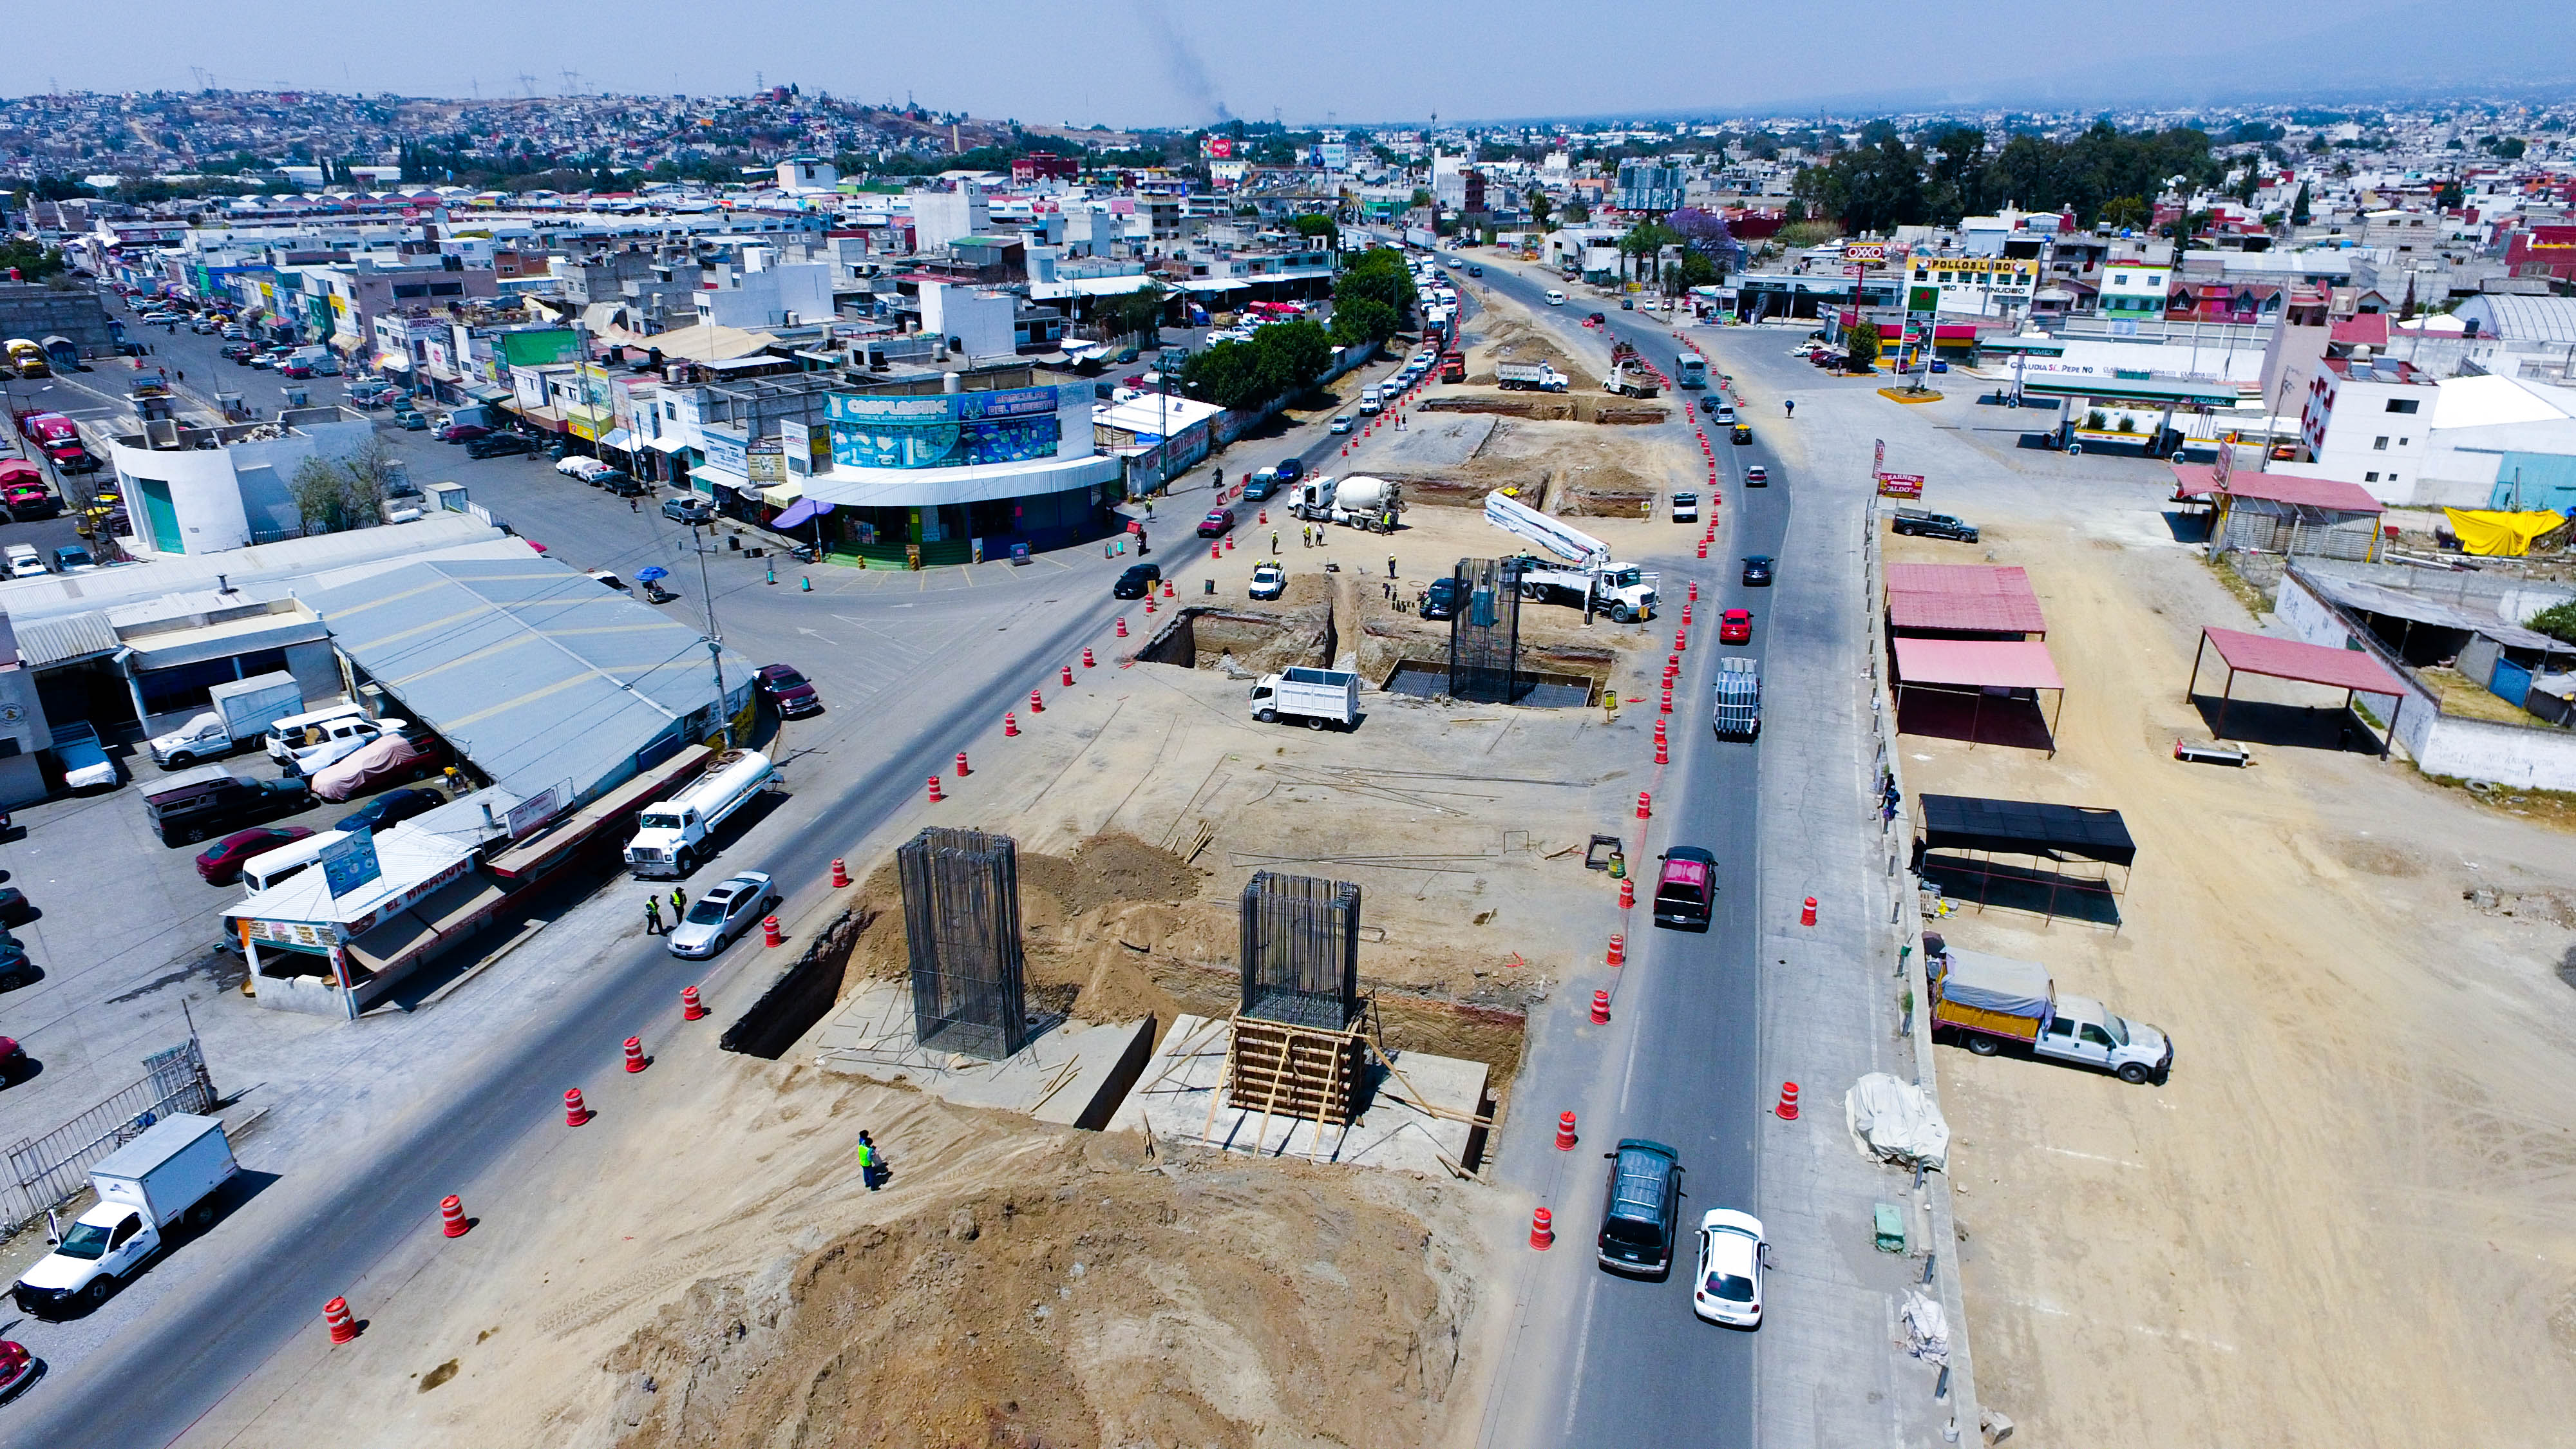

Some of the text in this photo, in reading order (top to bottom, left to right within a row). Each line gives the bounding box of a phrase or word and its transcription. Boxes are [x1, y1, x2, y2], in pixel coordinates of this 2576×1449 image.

[788, 234, 812, 243] DE
[1848, 247, 1881, 258] OXXO
[1932, 260, 1976, 270] POLLOS
[2010, 361, 2047, 372] CAUDIA
[995, 391, 1048, 404] BASCULAS
[2193, 397, 2226, 405] PEMEX
[987, 405, 1009, 416] DEL
[384, 900, 402, 913] EL
